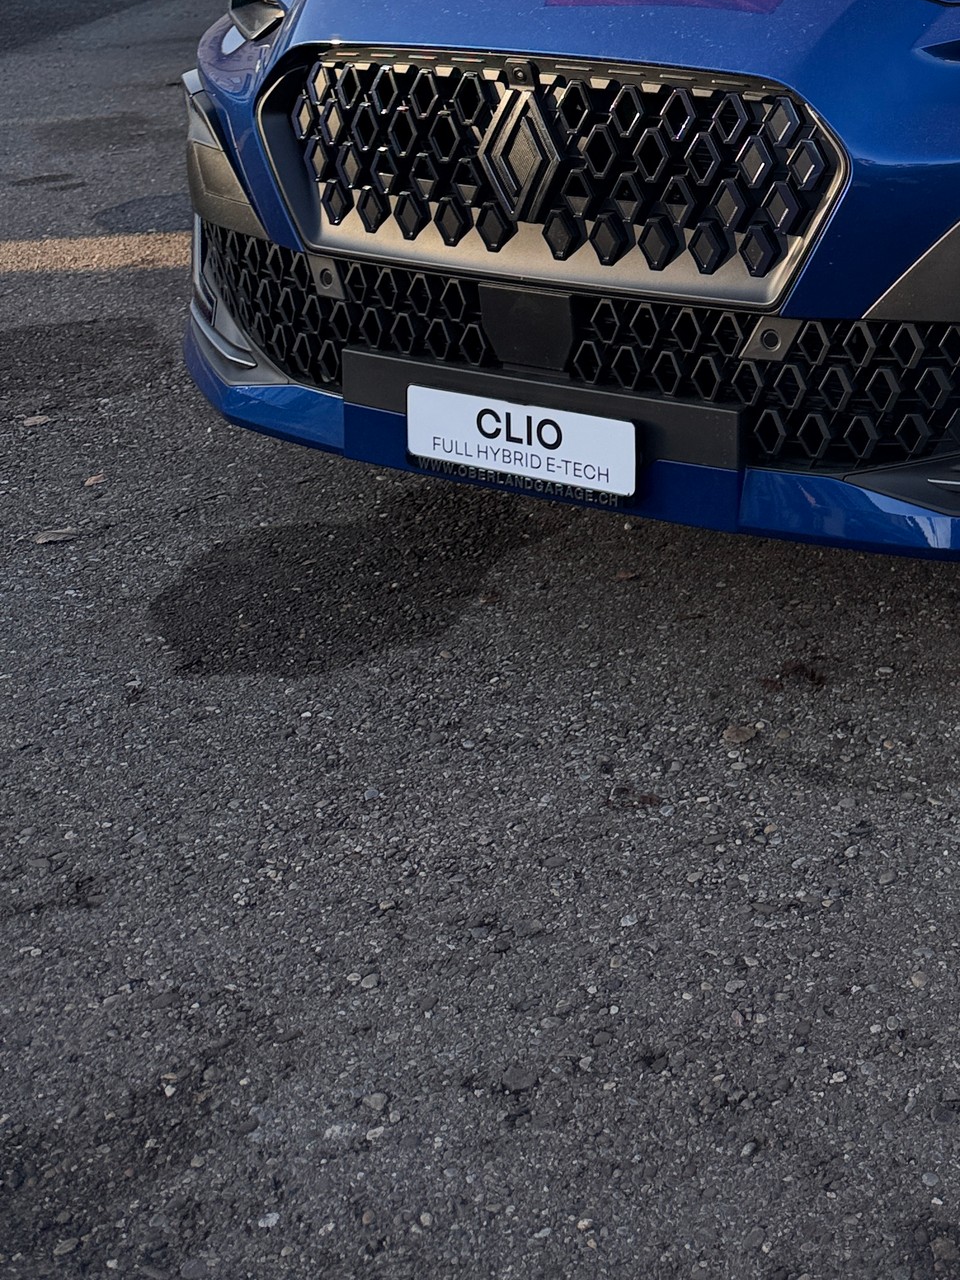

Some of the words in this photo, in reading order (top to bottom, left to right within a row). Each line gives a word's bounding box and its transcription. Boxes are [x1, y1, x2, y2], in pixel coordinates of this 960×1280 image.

[476, 408, 563, 450] CLIO
[417, 456, 619, 508] WWW.OBERLANDGARAGE.CH
[432, 436, 473, 458] FULL
[477, 444, 542, 470] HYBRID
[546, 456, 610, 483] E-TECH
